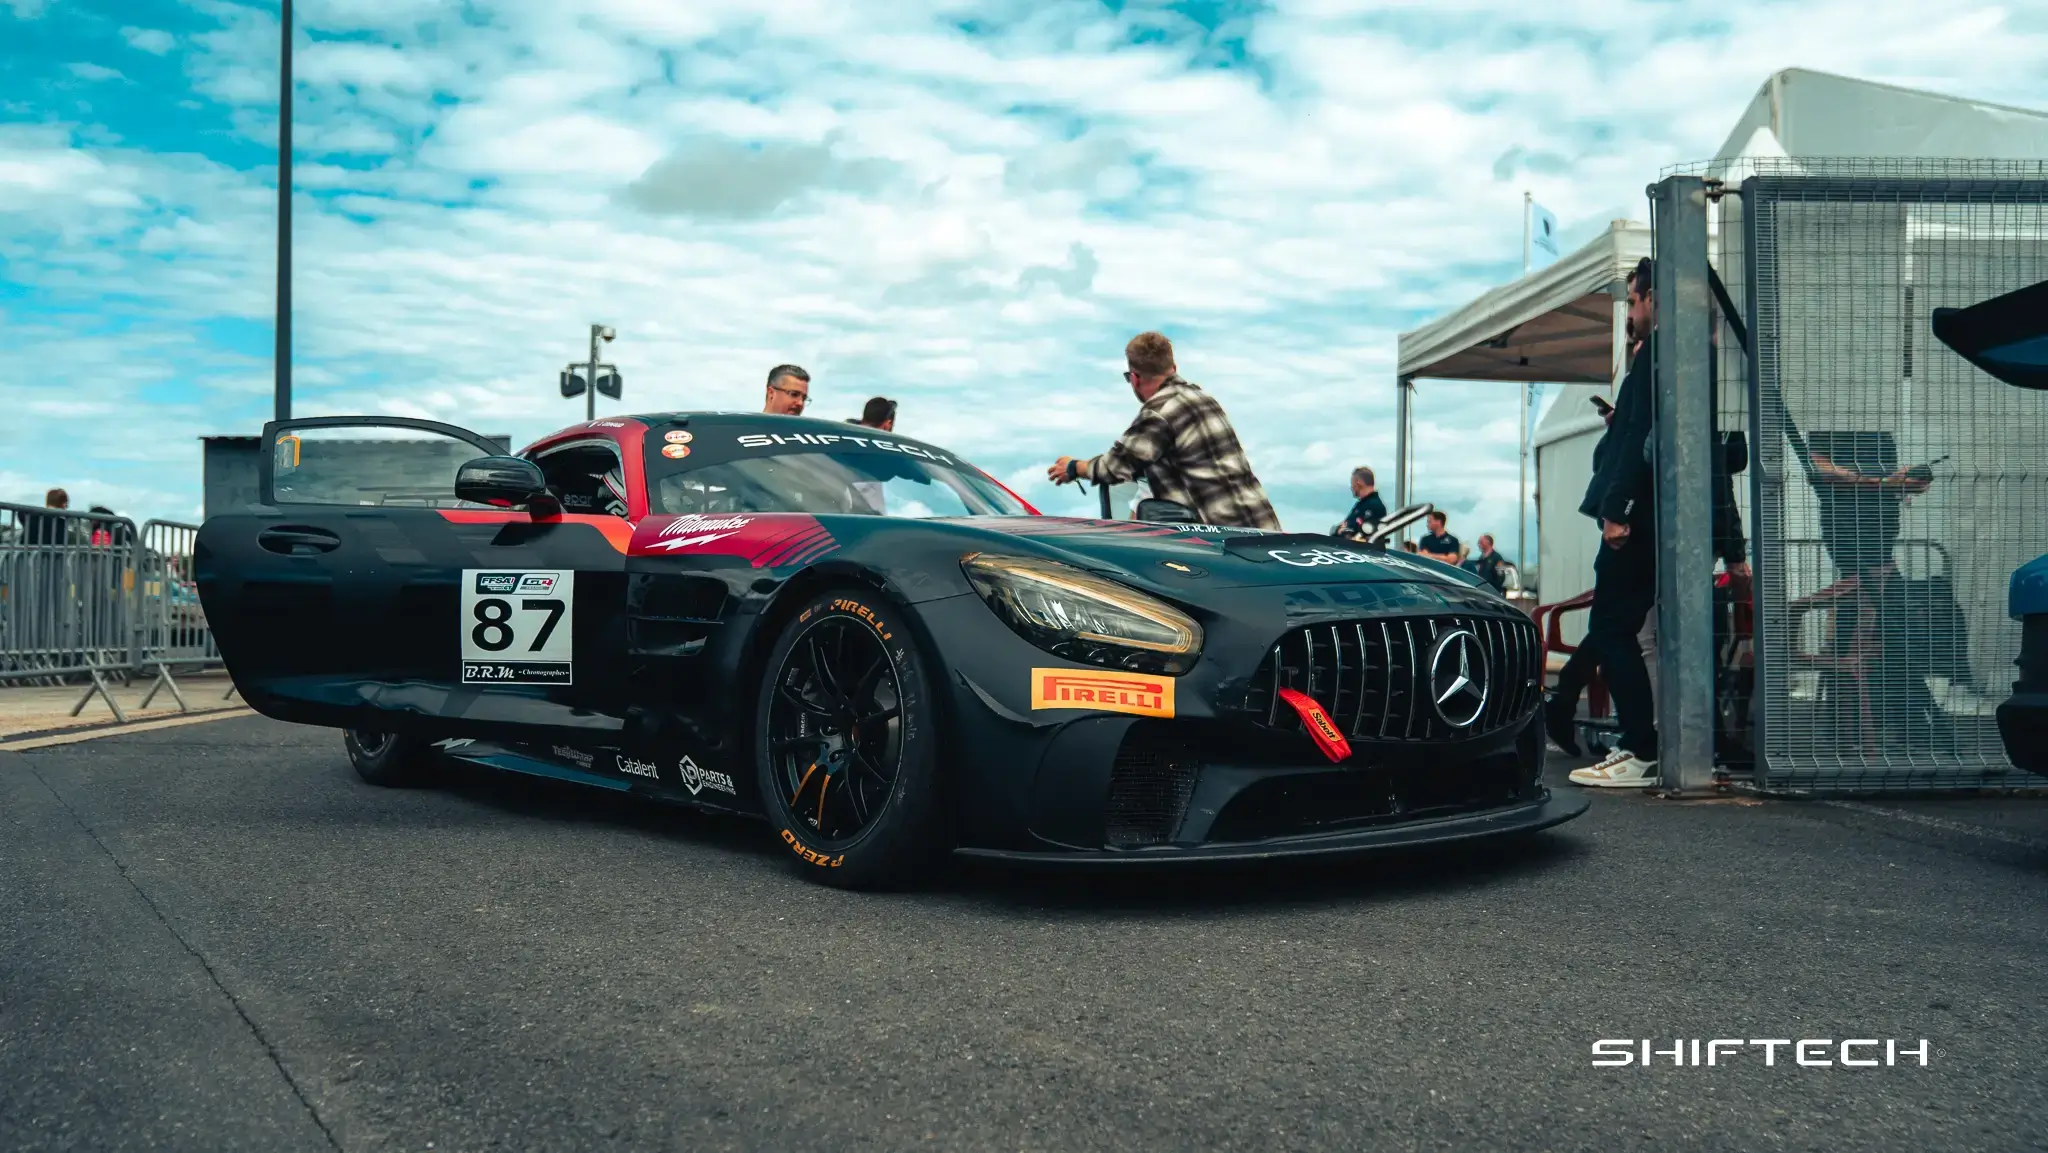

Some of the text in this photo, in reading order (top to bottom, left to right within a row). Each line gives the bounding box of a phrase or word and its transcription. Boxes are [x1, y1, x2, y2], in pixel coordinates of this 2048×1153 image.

[737, 434, 954, 465] SHIFTECH
[659, 514, 751, 537] Milwaukee
[472, 598, 565, 652] 87
[829, 599, 892, 640] PIRELLI
[1043, 676, 1163, 709] PIRELLI
[616, 755, 659, 779] Catalent
[699, 768, 734, 787] PARTS &
